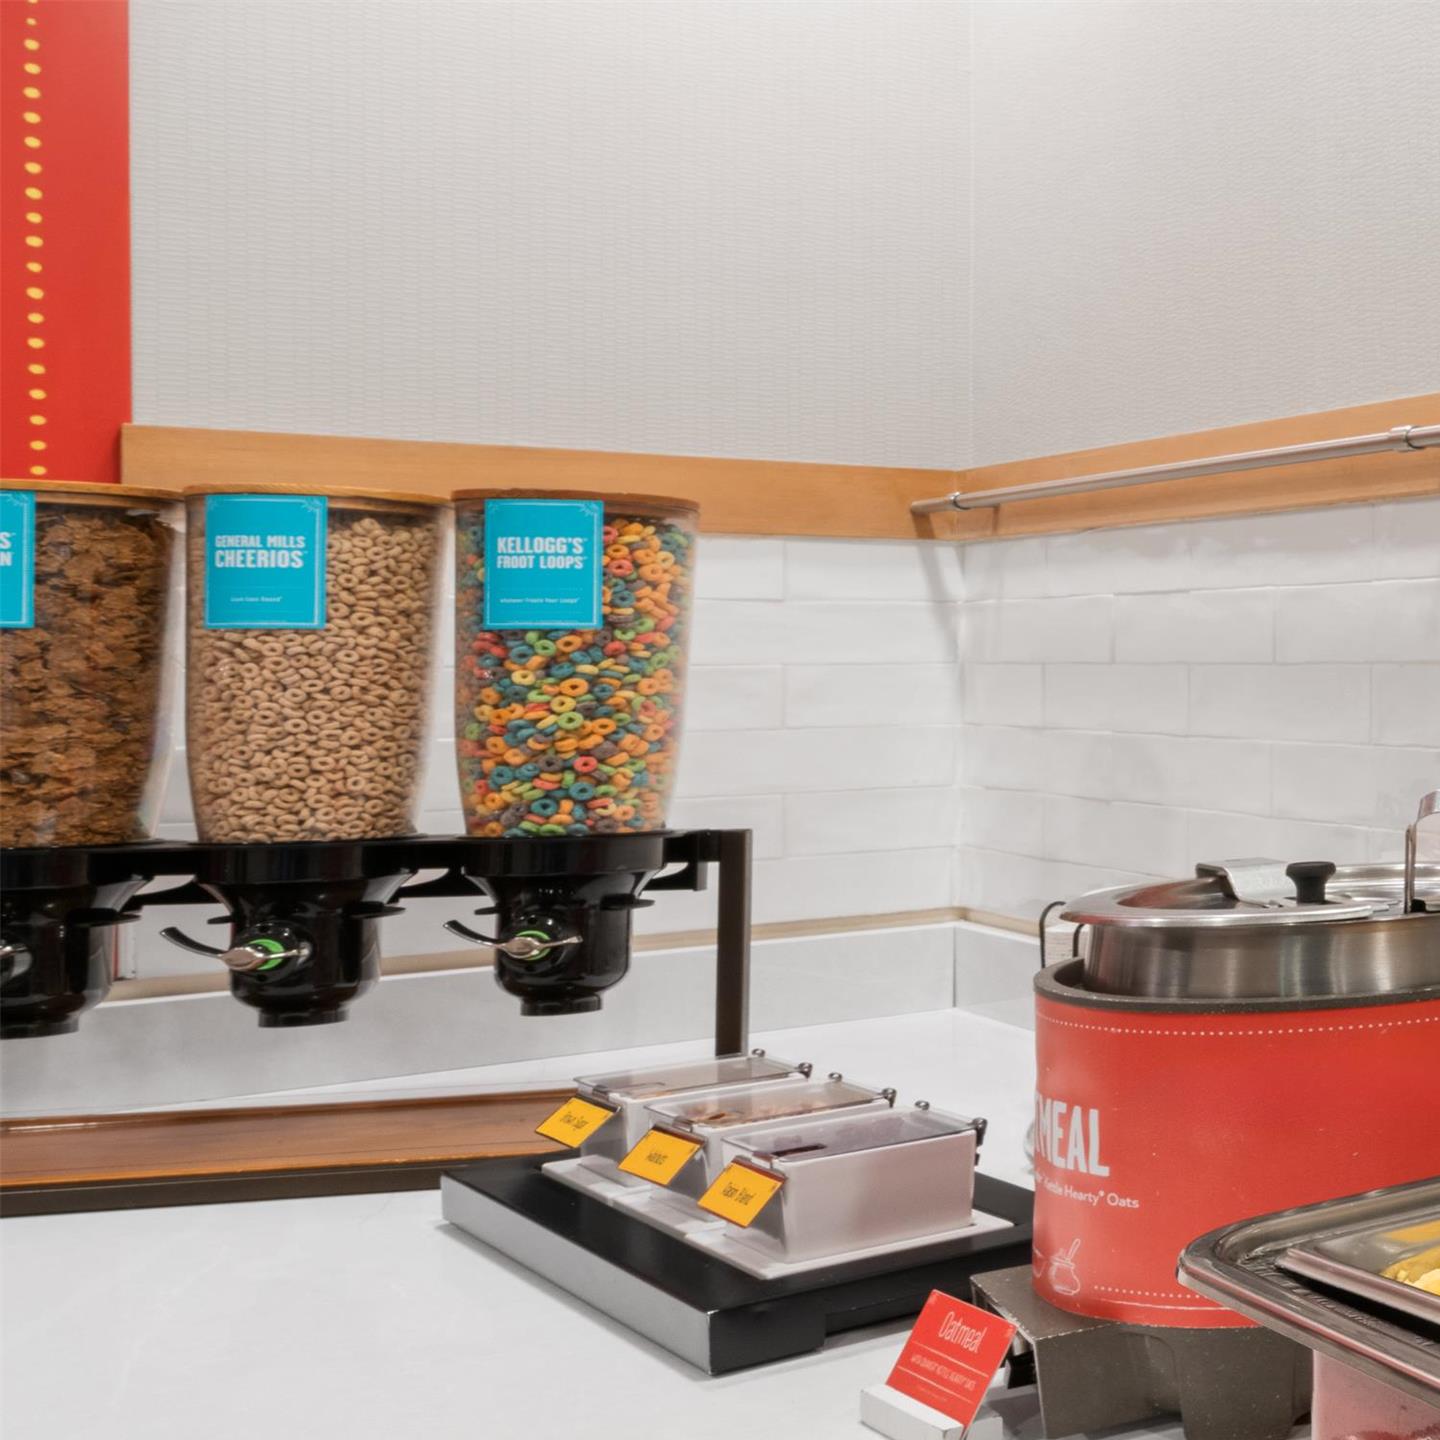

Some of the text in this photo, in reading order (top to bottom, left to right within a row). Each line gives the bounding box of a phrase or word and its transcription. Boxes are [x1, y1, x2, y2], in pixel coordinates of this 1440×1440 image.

[215, 535, 306, 549] GENERAL MILLS
[497, 536, 583, 554] KELLOGG'S
[215, 549, 304, 569] CHEERIOS
[496, 555, 583, 569] FROOT LOOPS
[1107, 1192, 1140, 1208] Oats
[938, 1311, 988, 1354] Oatmeal
